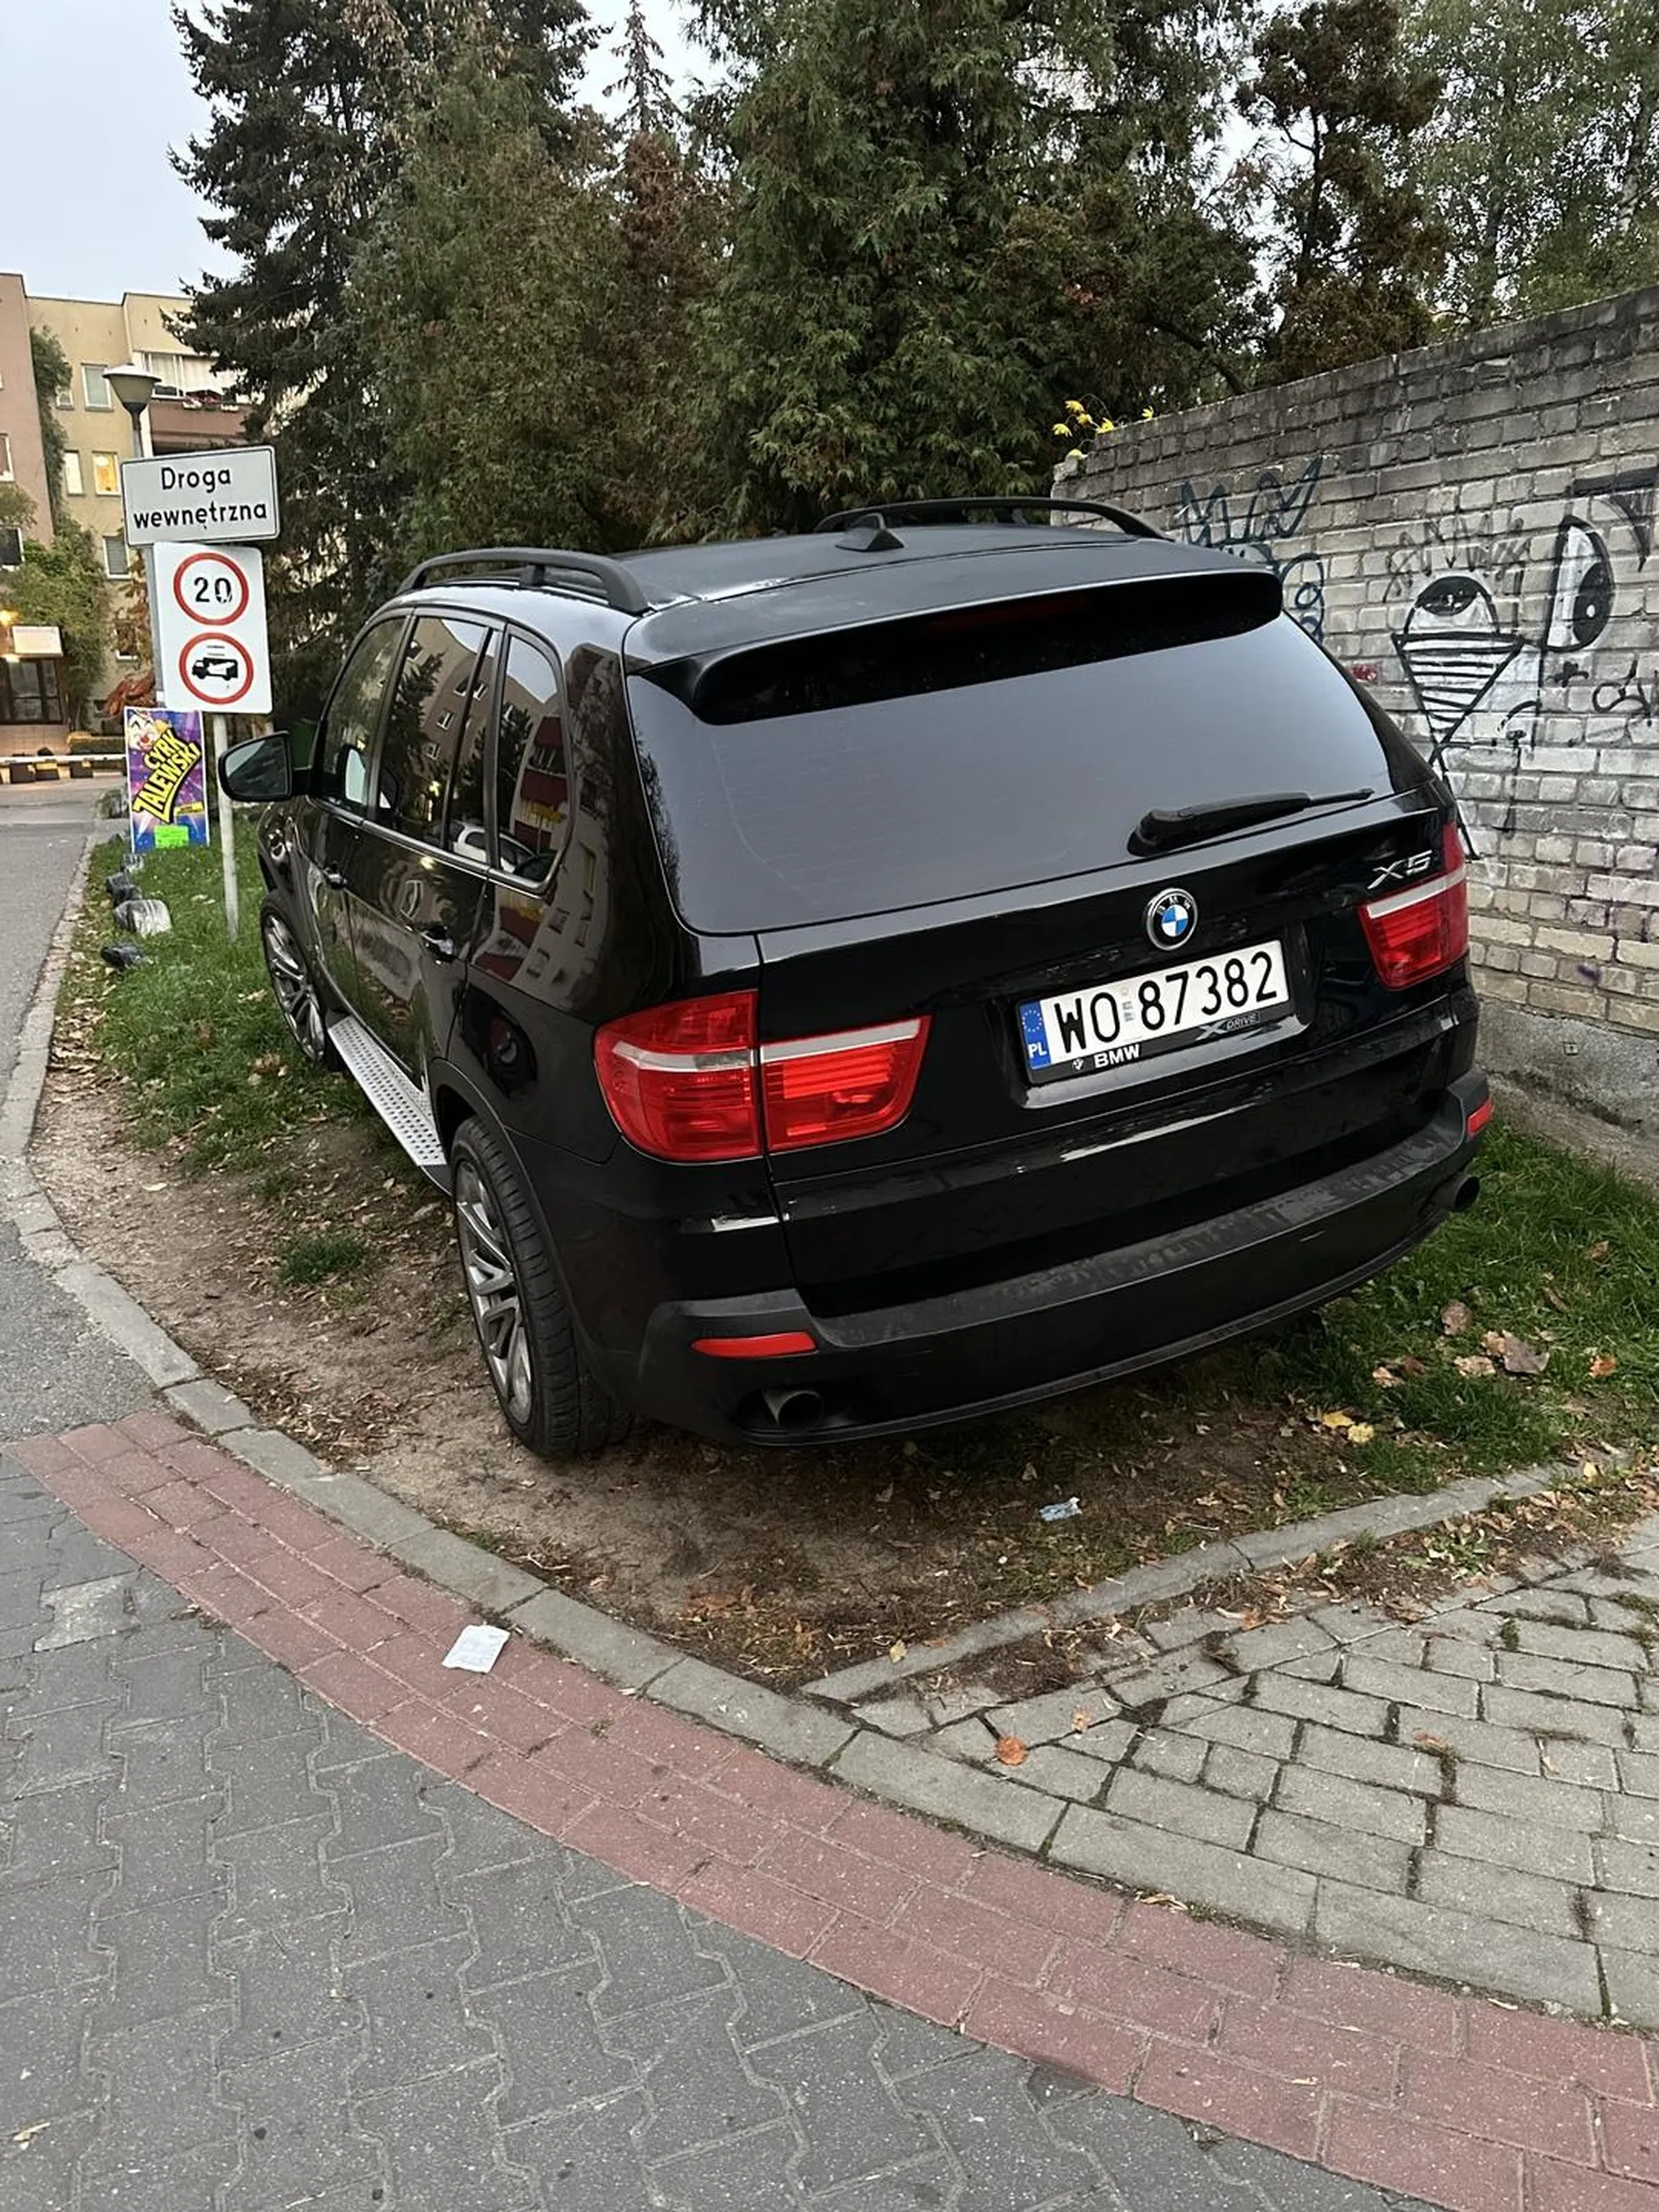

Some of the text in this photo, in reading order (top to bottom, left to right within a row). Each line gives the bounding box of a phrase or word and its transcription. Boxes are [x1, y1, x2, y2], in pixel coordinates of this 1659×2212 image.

[161, 467, 231, 493] Droga
[134, 502, 267, 530] wewnętrzna
[194, 577, 233, 603] 20
[143, 728, 188, 770] CYRK
[133, 741, 202, 824] ZALEWSKI
[1367, 849, 1432, 890] X5
[1054, 951, 1278, 1053] WO 87382
[1027, 1042, 1048, 1058] PL
[1094, 1044, 1141, 1068] BMW
